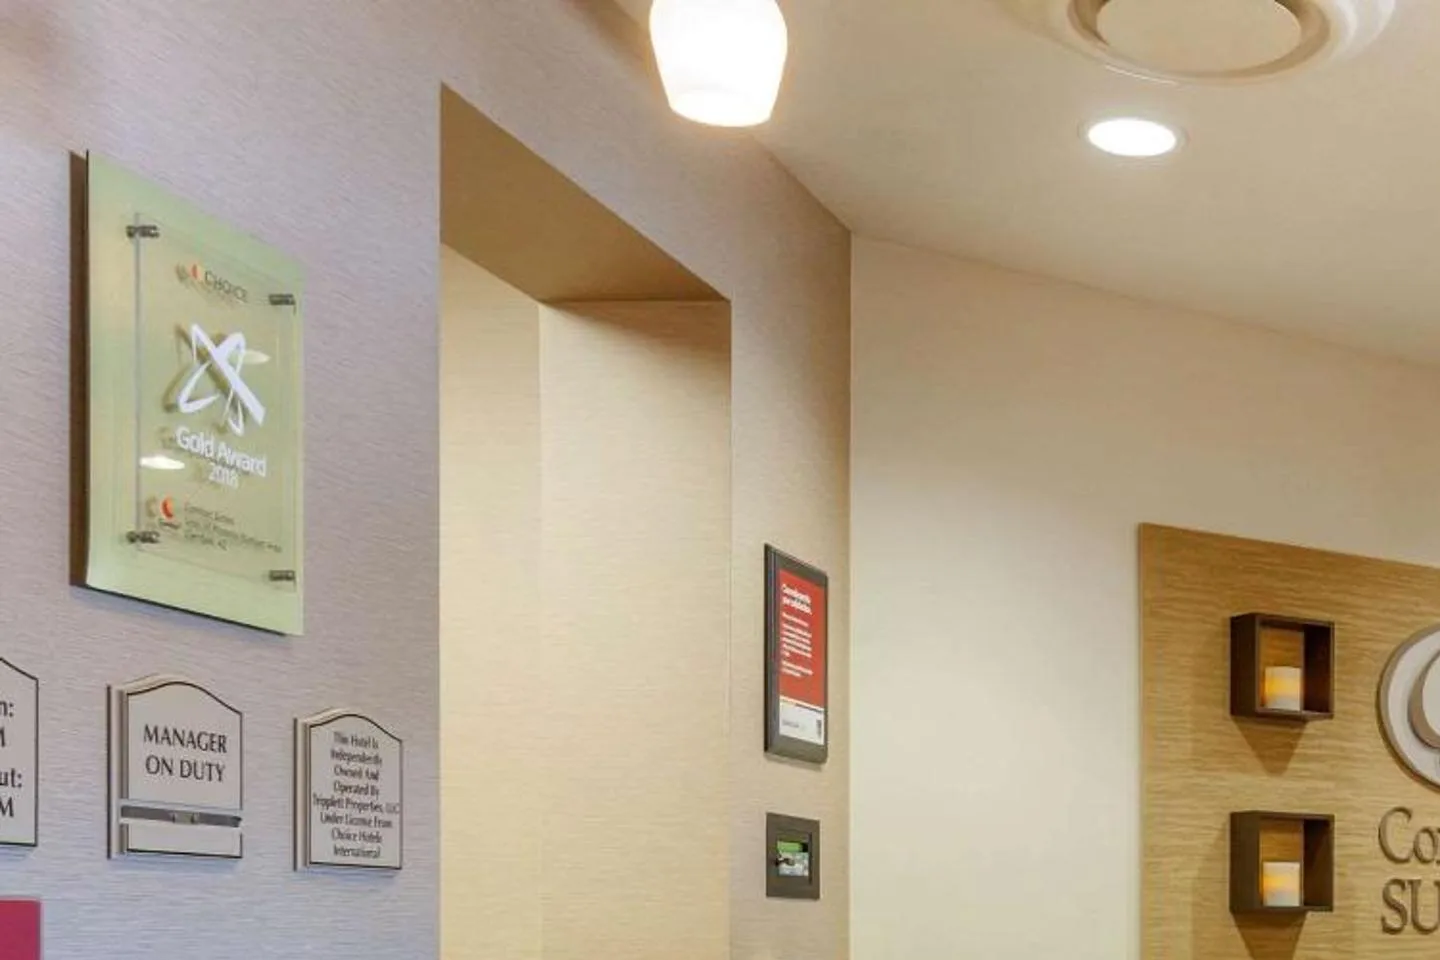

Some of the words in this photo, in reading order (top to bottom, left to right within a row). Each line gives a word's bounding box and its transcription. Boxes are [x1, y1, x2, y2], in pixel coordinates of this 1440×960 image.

[175, 425, 215, 458] Gold
[216, 441, 267, 478] Award
[143, 723, 228, 754] MANAGER
[351, 735, 371, 749] Hotel
[145, 754, 174, 777] ON
[179, 759, 226, 782] DUTY
[333, 780, 369, 796] Operated
[320, 811, 344, 825] Under
